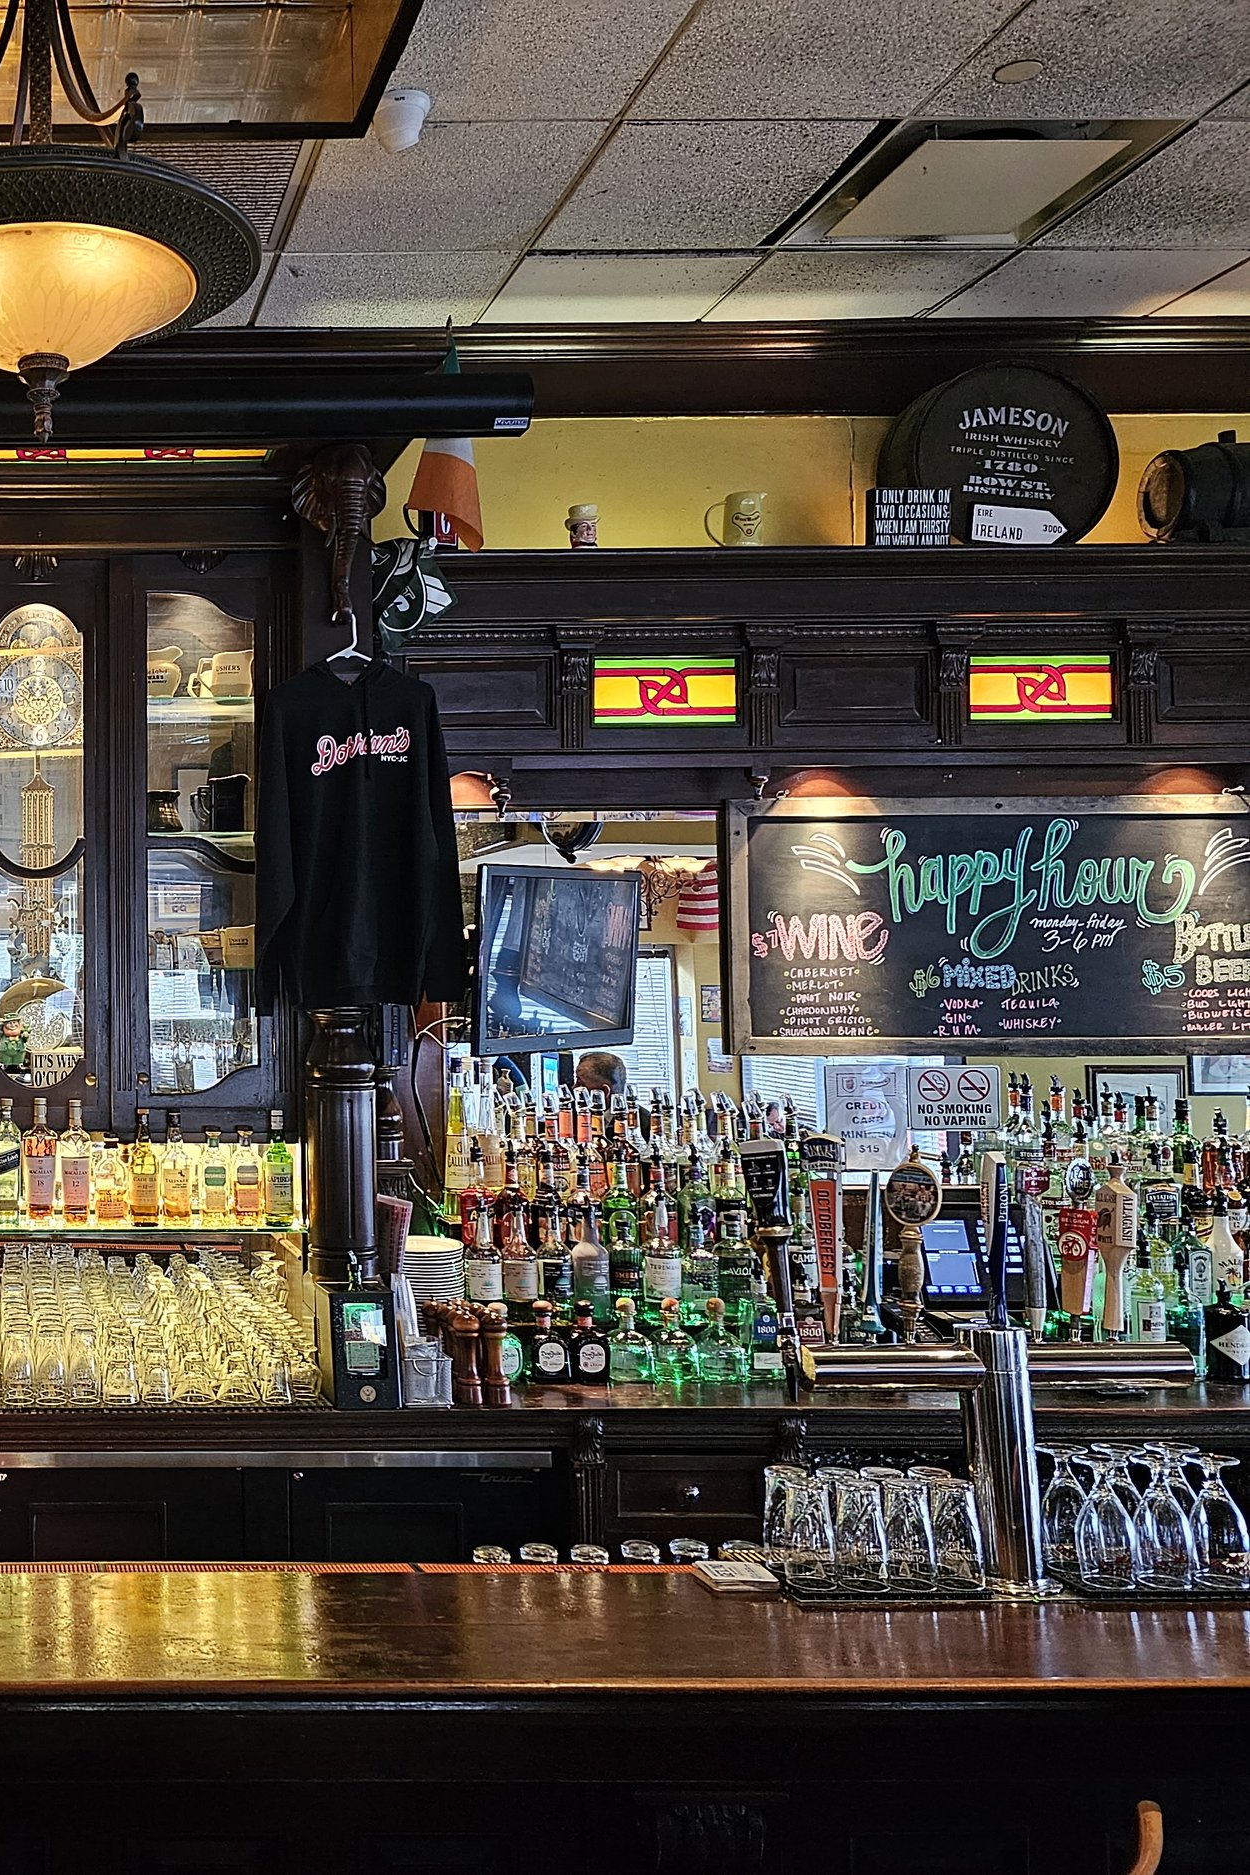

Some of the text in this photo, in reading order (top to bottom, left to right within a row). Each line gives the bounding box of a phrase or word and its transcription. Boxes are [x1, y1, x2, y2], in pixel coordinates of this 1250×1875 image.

[958, 407, 1070, 438] JAMESON
[965, 432, 1061, 448] IRISH WHISKEY
[950, 446, 1075, 464] TRIPLE DISTILLED SINCE
[968, 476, 1050, 491] BOW ST.
[883, 490, 950, 503] ONLY DRINK ON
[962, 485, 1055, 500] DISTILLERY
[875, 505, 950, 518] TWO OCCASIONS:
[977, 508, 993, 517] EIRE
[875, 520, 950, 534] WHEN AM THIRSTY
[975, 523, 1064, 541] IRELAND 3000
[381, 755, 408, 763] NYC-JC
[846, 818, 1196, 959] happy hour
[752, 929, 778, 958] $7
[790, 967, 854, 978] CABERNET
[909, 957, 1074, 998] $6 MIXED DRINKS
[1142, 960, 1185, 995] $5
[792, 980, 839, 991] MERLOT
[829, 992, 857, 1002] NOIR
[943, 999, 980, 1010] VODKA
[1002, 998, 1057, 1010] TEQUILA
[1187, 1000, 1209, 1008] BUD
[786, 1005, 855, 1016] CHARDONNAY
[1188, 1009, 1250, 1019] BUDWEISE
[790, 1016, 865, 1026] PINOT GRIGIO
[945, 1014, 967, 1023] GIN
[1003, 1018, 1057, 1031] WHISKEY
[779, 1026, 874, 1037] SAUVIGNON BLANC
[938, 1025, 978, 1036] RUM
[34, 1054, 53, 1068] IT'S
[917, 1103, 992, 1114] NO SMOKING
[924, 1115, 987, 1126] NO VAPING
[998, 1183, 1008, 1222] PERONI
[1122, 1196, 1133, 1241] ALLAGASH
[817, 1189, 835, 1275] OCTOBERFEST
[757, 1326, 776, 1334] 1800
[800, 1328, 821, 1337] 1800
